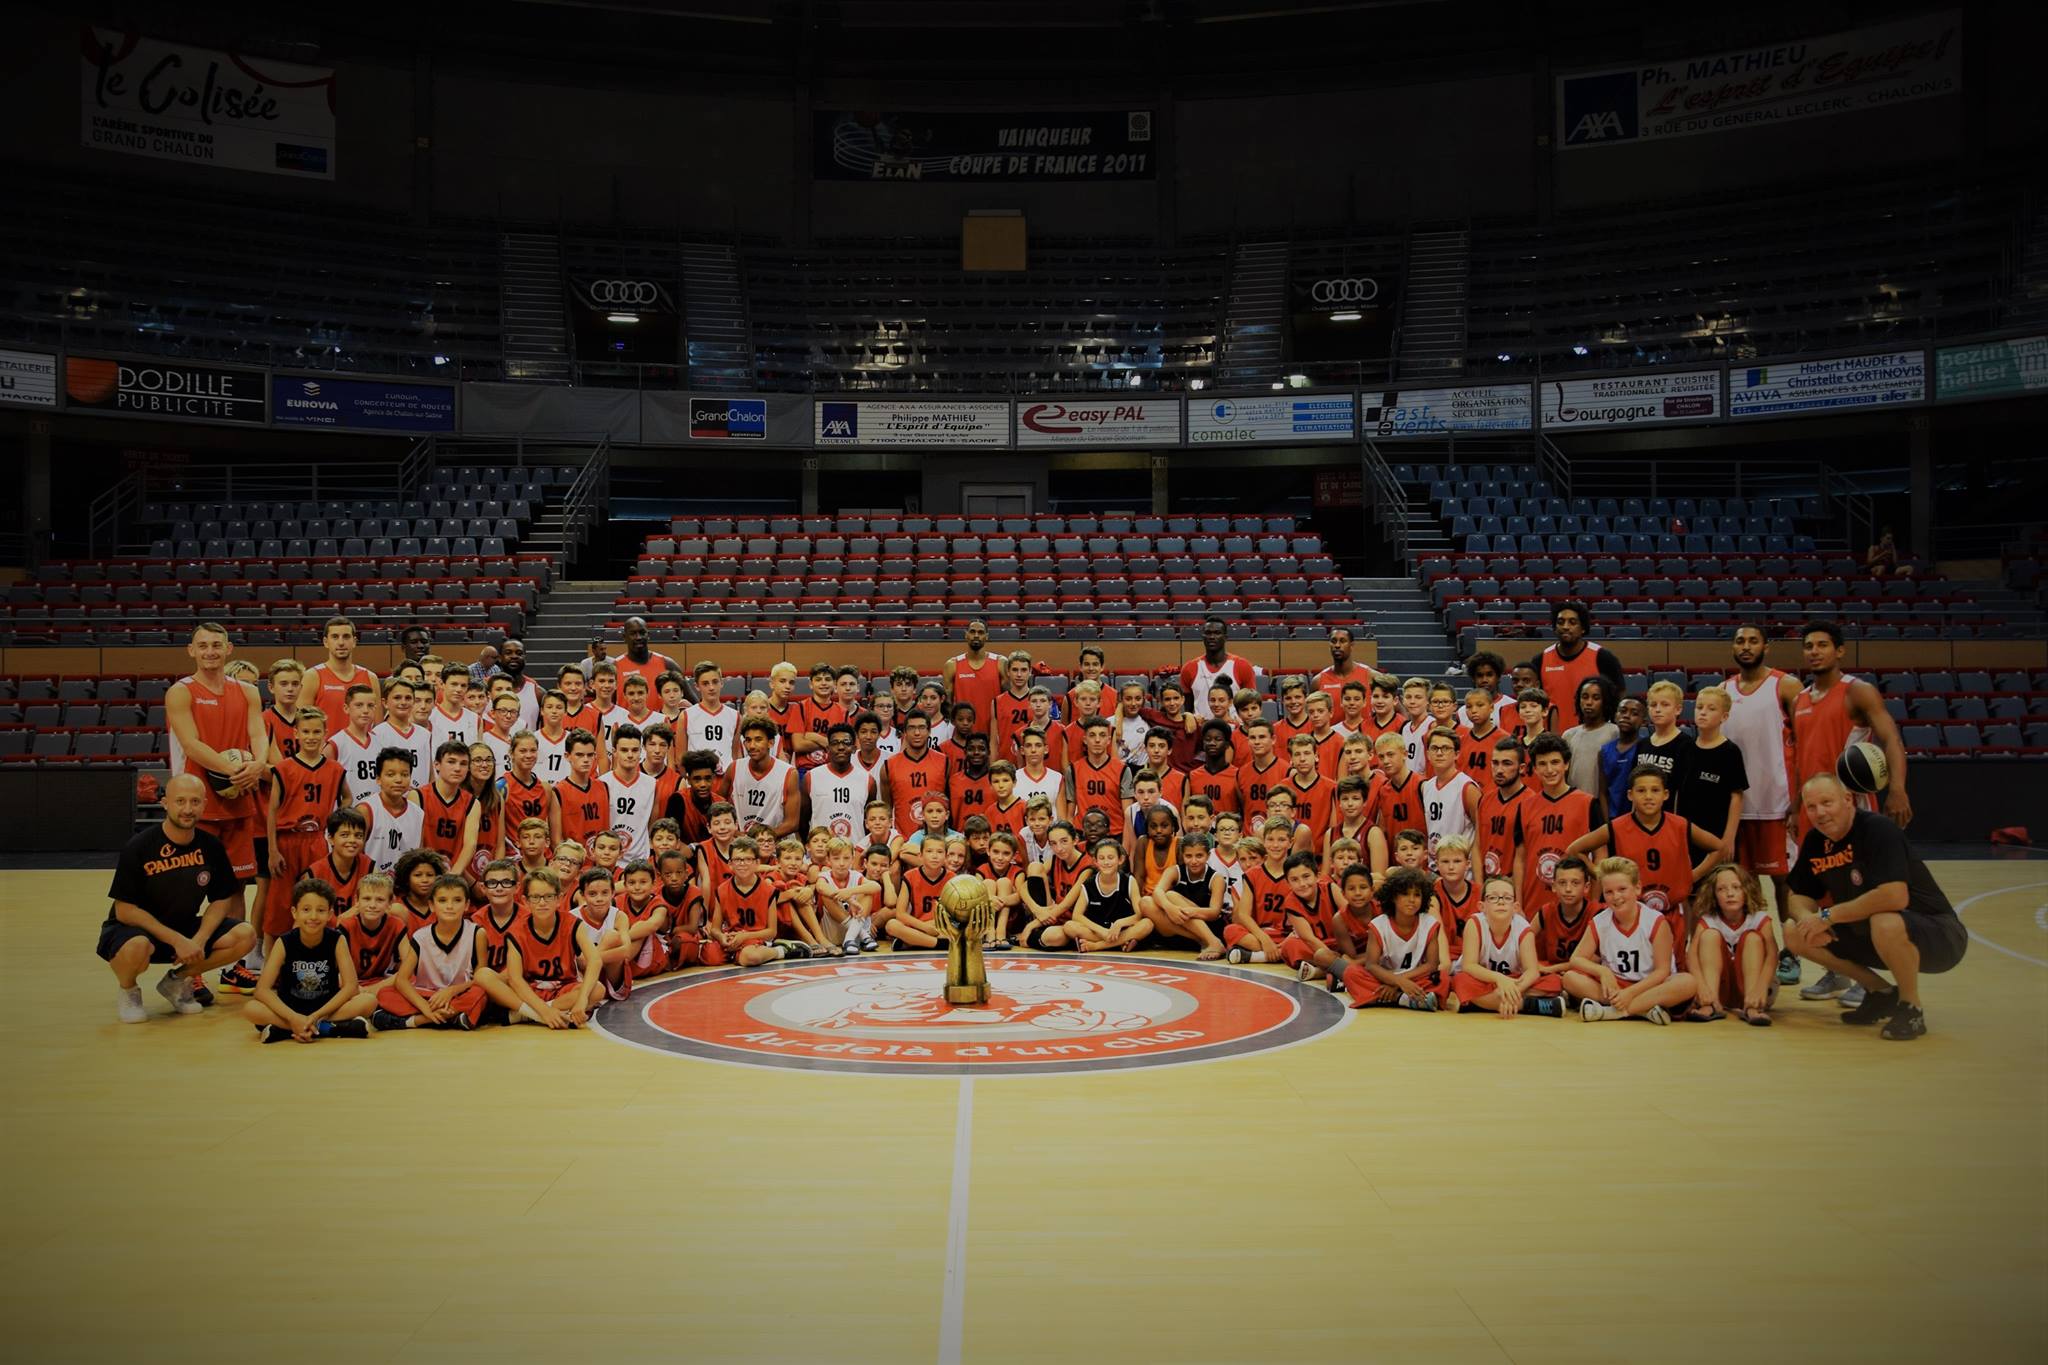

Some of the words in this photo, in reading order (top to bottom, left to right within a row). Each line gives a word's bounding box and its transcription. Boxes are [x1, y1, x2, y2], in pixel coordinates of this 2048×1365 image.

[1641, 66, 1677, 87] Ph.
[1686, 45, 1808, 82] MATHIEU
[139, 54, 281, 125] Colisée
[141, 124, 195, 142] SPORTIVE
[198, 130, 214, 144] DU
[1568, 111, 1626, 142] AXA
[1654, 121, 1687, 137] RUE
[1688, 118, 1709, 132] DU
[92, 129, 148, 150] GRAND
[152, 139, 215, 161] CHALON
[996, 127, 1092, 148] VAINQUEUR
[948, 155, 1003, 177] COUPE
[1009, 156, 1034, 176] DE
[1034, 154, 1097, 175] FRANCE
[1102, 152, 1147, 174] 2011
[1800, 362, 1841, 375] Hubert
[1843, 355, 1895, 370] MAUDET
[118, 366, 234, 397] DODILLE
[1592, 378, 1669, 391] RESTAURANT
[1674, 374, 1716, 384] CUISINE
[1787, 375, 1844, 389] Christelle
[1846, 364, 1923, 383] CORTINOVIS
[1594, 387, 1667, 398] TRADITIONNELLE
[1733, 389, 1782, 403] AVIVA
[118, 393, 234, 417] PUBLICITE
[286, 398, 339, 411] EUROVIA
[1452, 397, 1528, 409] ORGANISATION
[305, 416, 336, 424] VINCI
[892, 414, 931, 423] Philippe
[932, 414, 977, 422] MATHIEU
[1068, 410, 1110, 425] easy
[1113, 406, 1146, 421] PAL
[822, 420, 851, 436] AXA
[1192, 427, 1257, 441] comalec
[1011, 708, 1029, 725] 24
[704, 724, 723, 742] 69
[356, 760, 378, 780] 85
[547, 753, 563, 771] 17
[1468, 751, 1487, 770] 44
[910, 771, 928, 789] 121
[1087, 779, 1107, 797] 90
[303, 783, 322, 804] 31
[747, 789, 767, 808] 122
[832, 787, 851, 804] 119
[964, 788, 985, 806] 84
[1249, 783, 1267, 801] 89
[581, 802, 600, 821] 102
[616, 796, 636, 816] 92
[1541, 813, 1564, 835] 104
[144, 848, 205, 877] SPALDING
[1646, 847, 1661, 872] 9
[1263, 893, 1285, 913] 52
[736, 908, 756, 928] 30
[538, 956, 564, 978] 28
[1400, 951, 1413, 970] 4
[1617, 949, 1640, 973] 37
[984, 960, 1190, 988] halon
[727, 1030, 934, 1058] Au-delà
[955, 1040, 1094, 1059] d'un
[1102, 1029, 1205, 1050] club
